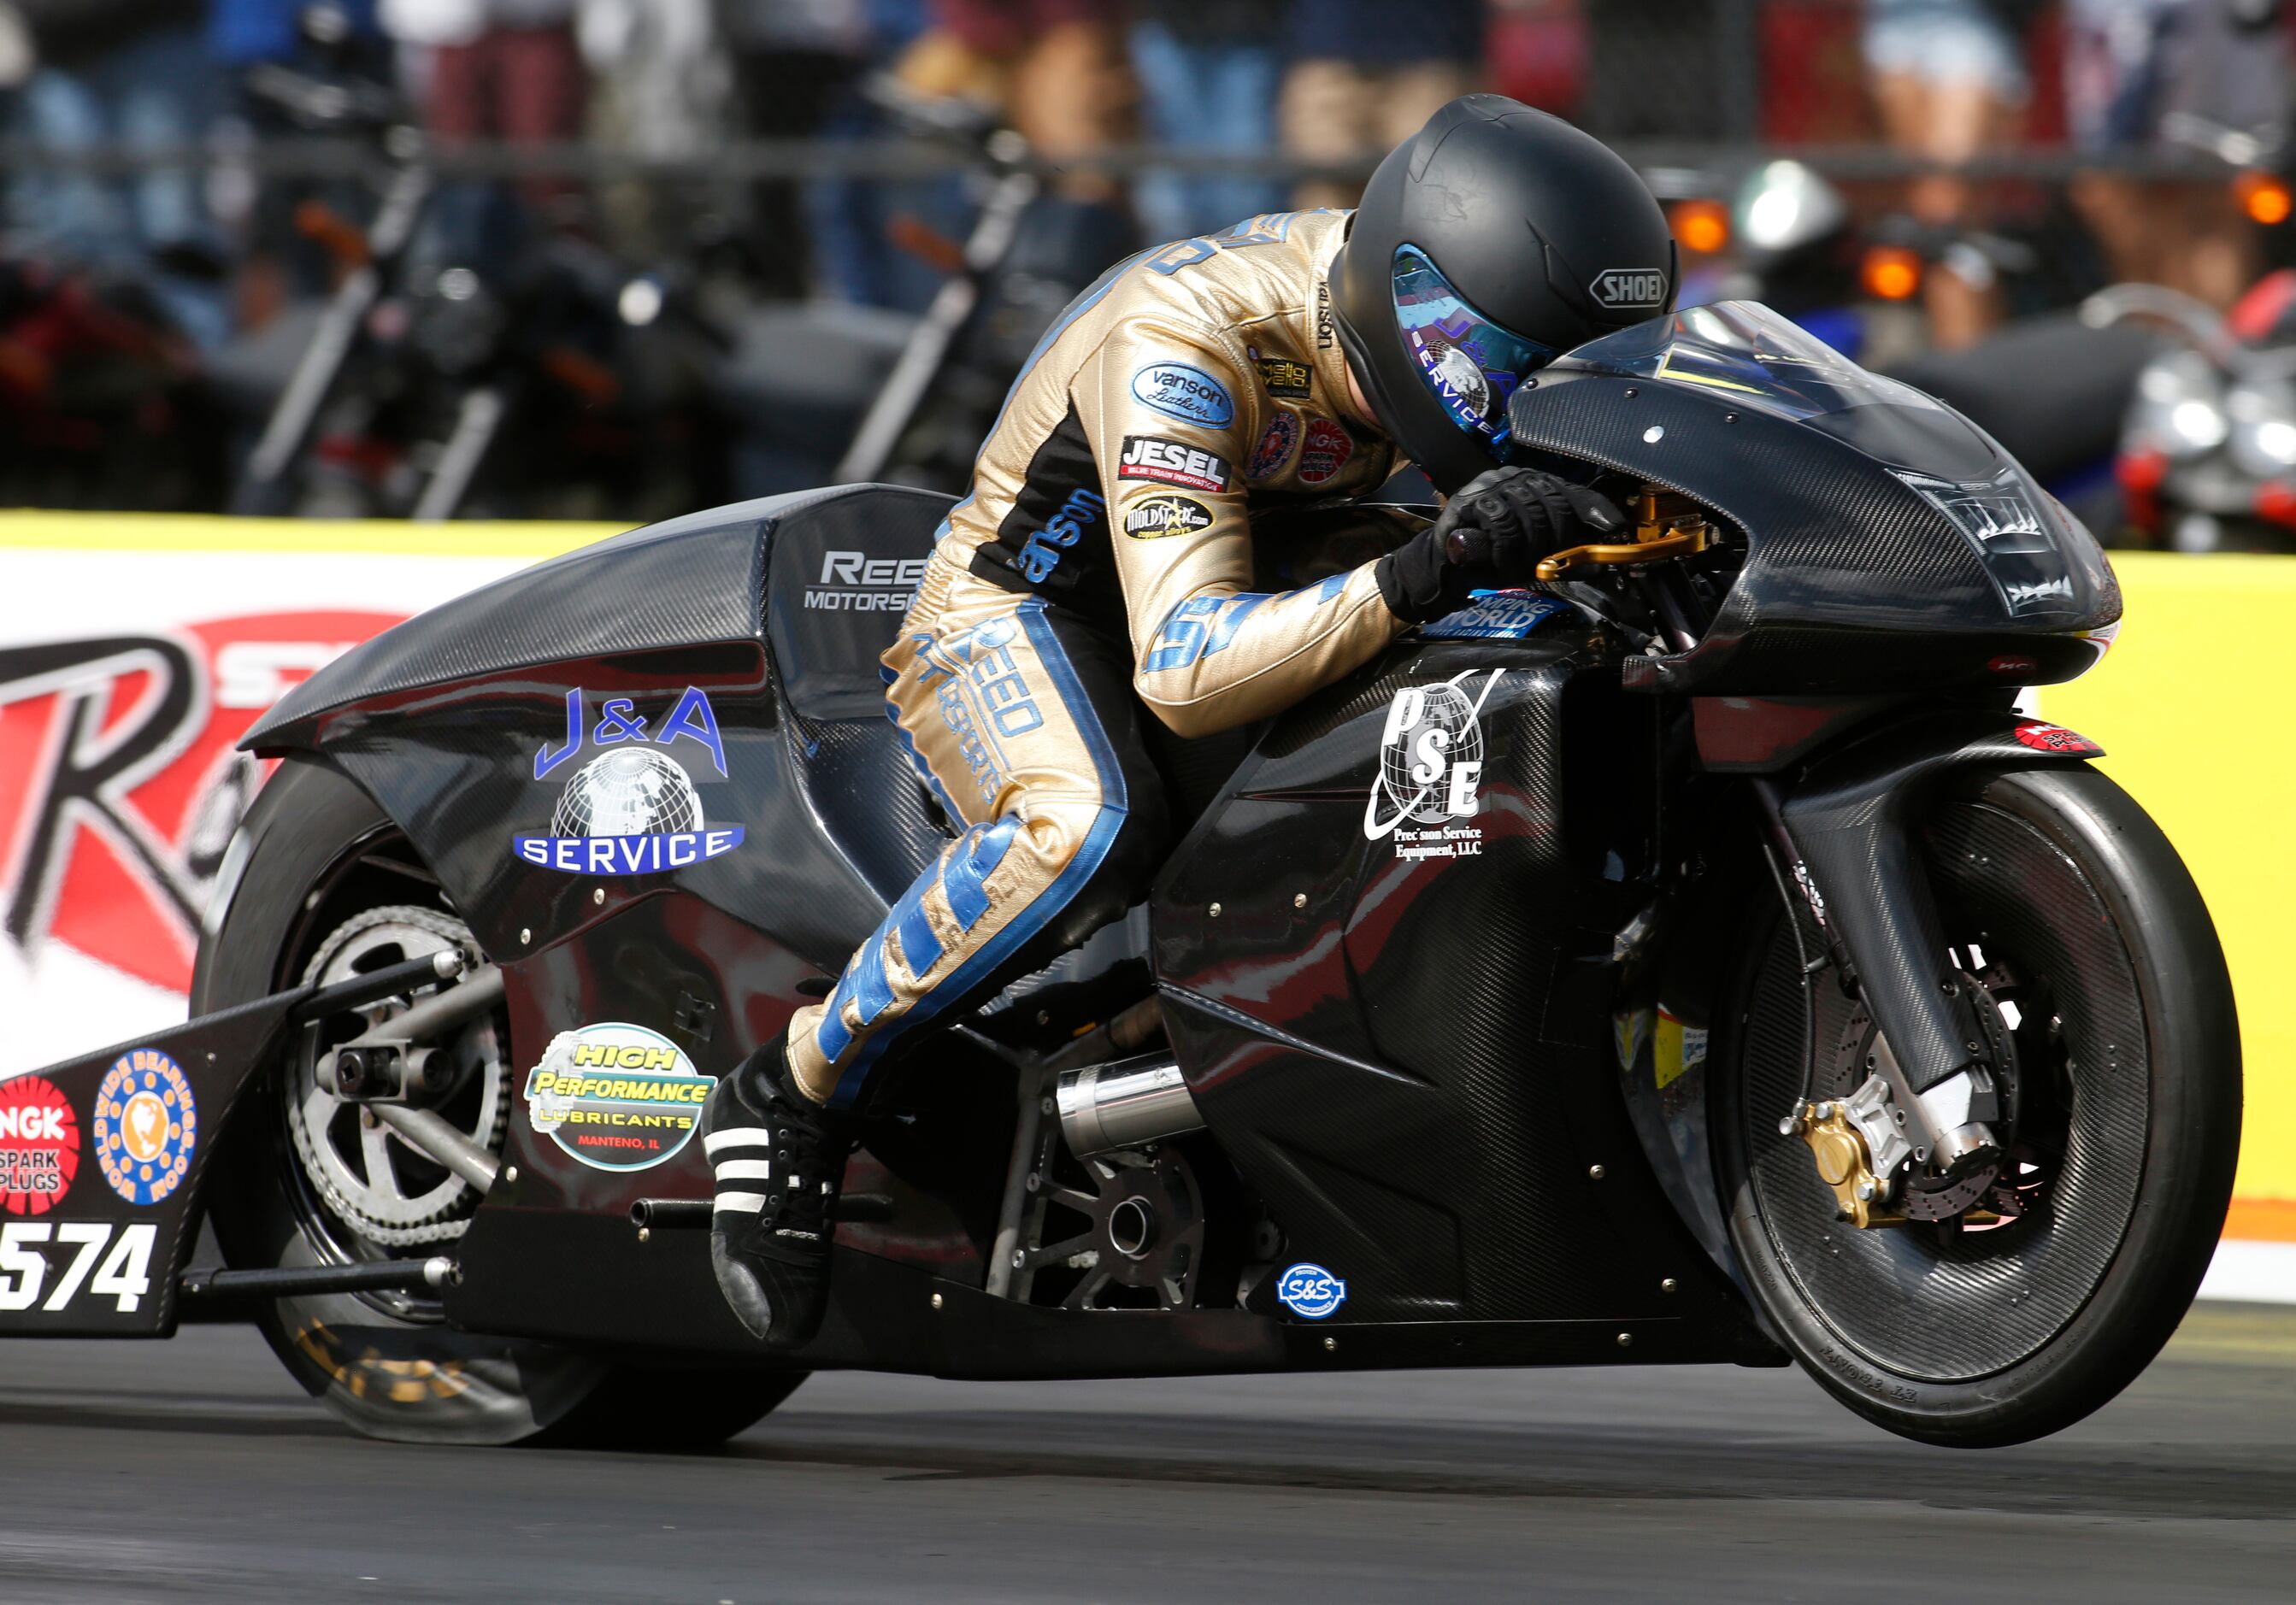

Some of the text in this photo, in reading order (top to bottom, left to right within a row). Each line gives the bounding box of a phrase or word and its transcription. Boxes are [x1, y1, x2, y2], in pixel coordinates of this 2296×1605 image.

[1604, 275, 1662, 301] SHOEI
[1153, 370, 1223, 407] vanson
[1411, 331, 1494, 434] SERVICE
[1146, 387, 1210, 419] Leathers
[1122, 439, 1224, 485] JESEL
[1018, 488, 1106, 583] anson
[821, 551, 927, 585] REE
[1474, 597, 1555, 614] MPING
[533, 685, 728, 781] J&A
[1393, 826, 1482, 842] Precsion Service
[523, 830, 733, 873] SERVICE
[1395, 841, 1482, 861] Equipment, LLC
[575, 1044, 678, 1070] HIGH
[533, 1071, 709, 1102] PERFORMANCE
[0, 1106, 66, 1141] NGK
[93, 1050, 196, 1202] WORLDWIDE BEARINGS.COM
[539, 1108, 692, 1129] LUBRICANTS
[577, 1135, 661, 1149] MANTENO, IL
[1287, 1279, 1332, 1300] S&S
